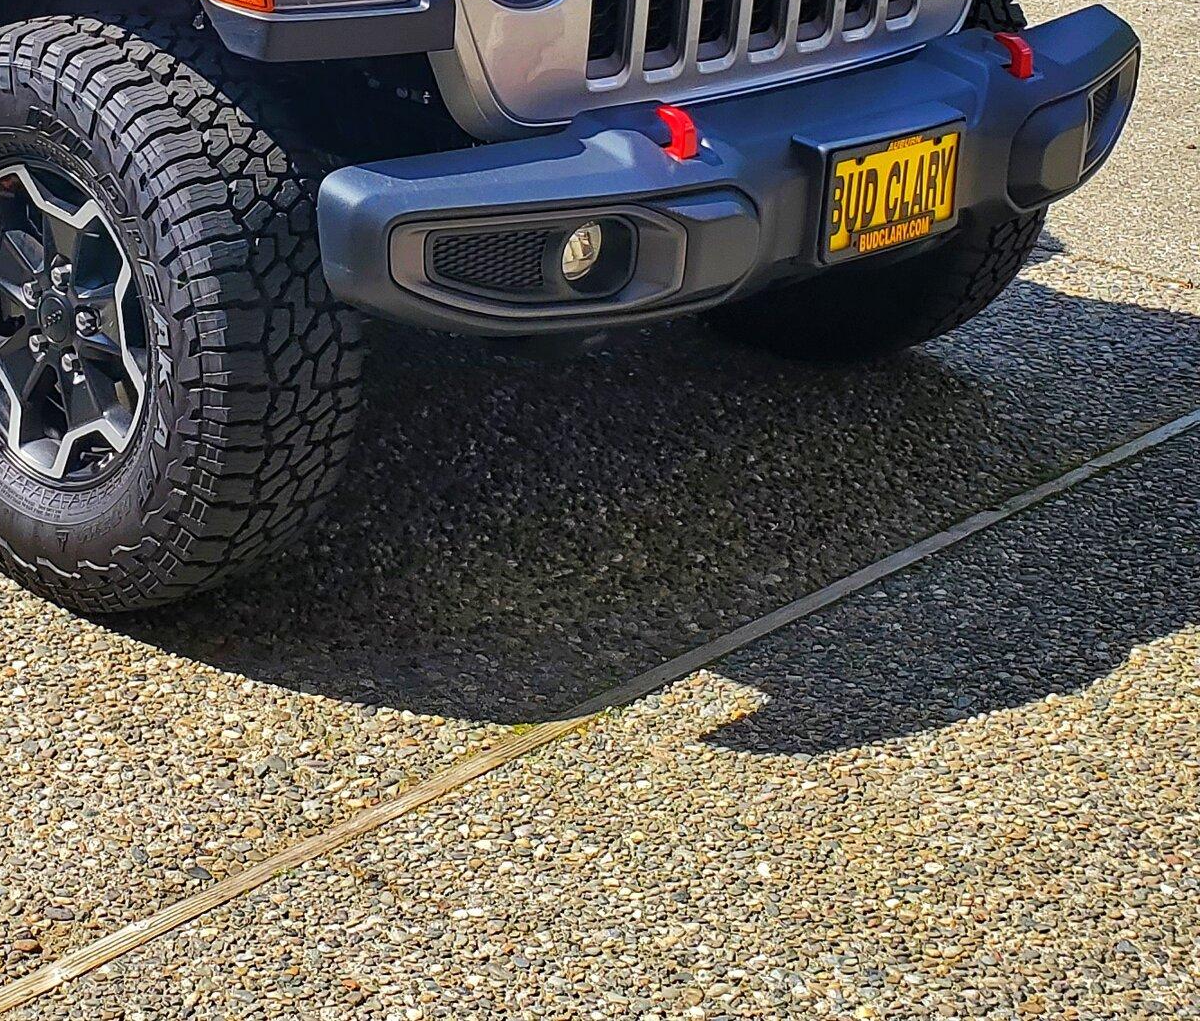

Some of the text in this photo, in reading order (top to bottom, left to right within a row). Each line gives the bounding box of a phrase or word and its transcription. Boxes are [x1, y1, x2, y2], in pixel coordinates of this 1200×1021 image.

[829, 145, 954, 236] BUD CLARY
[858, 215, 931, 253] BUDCLARY.COM
